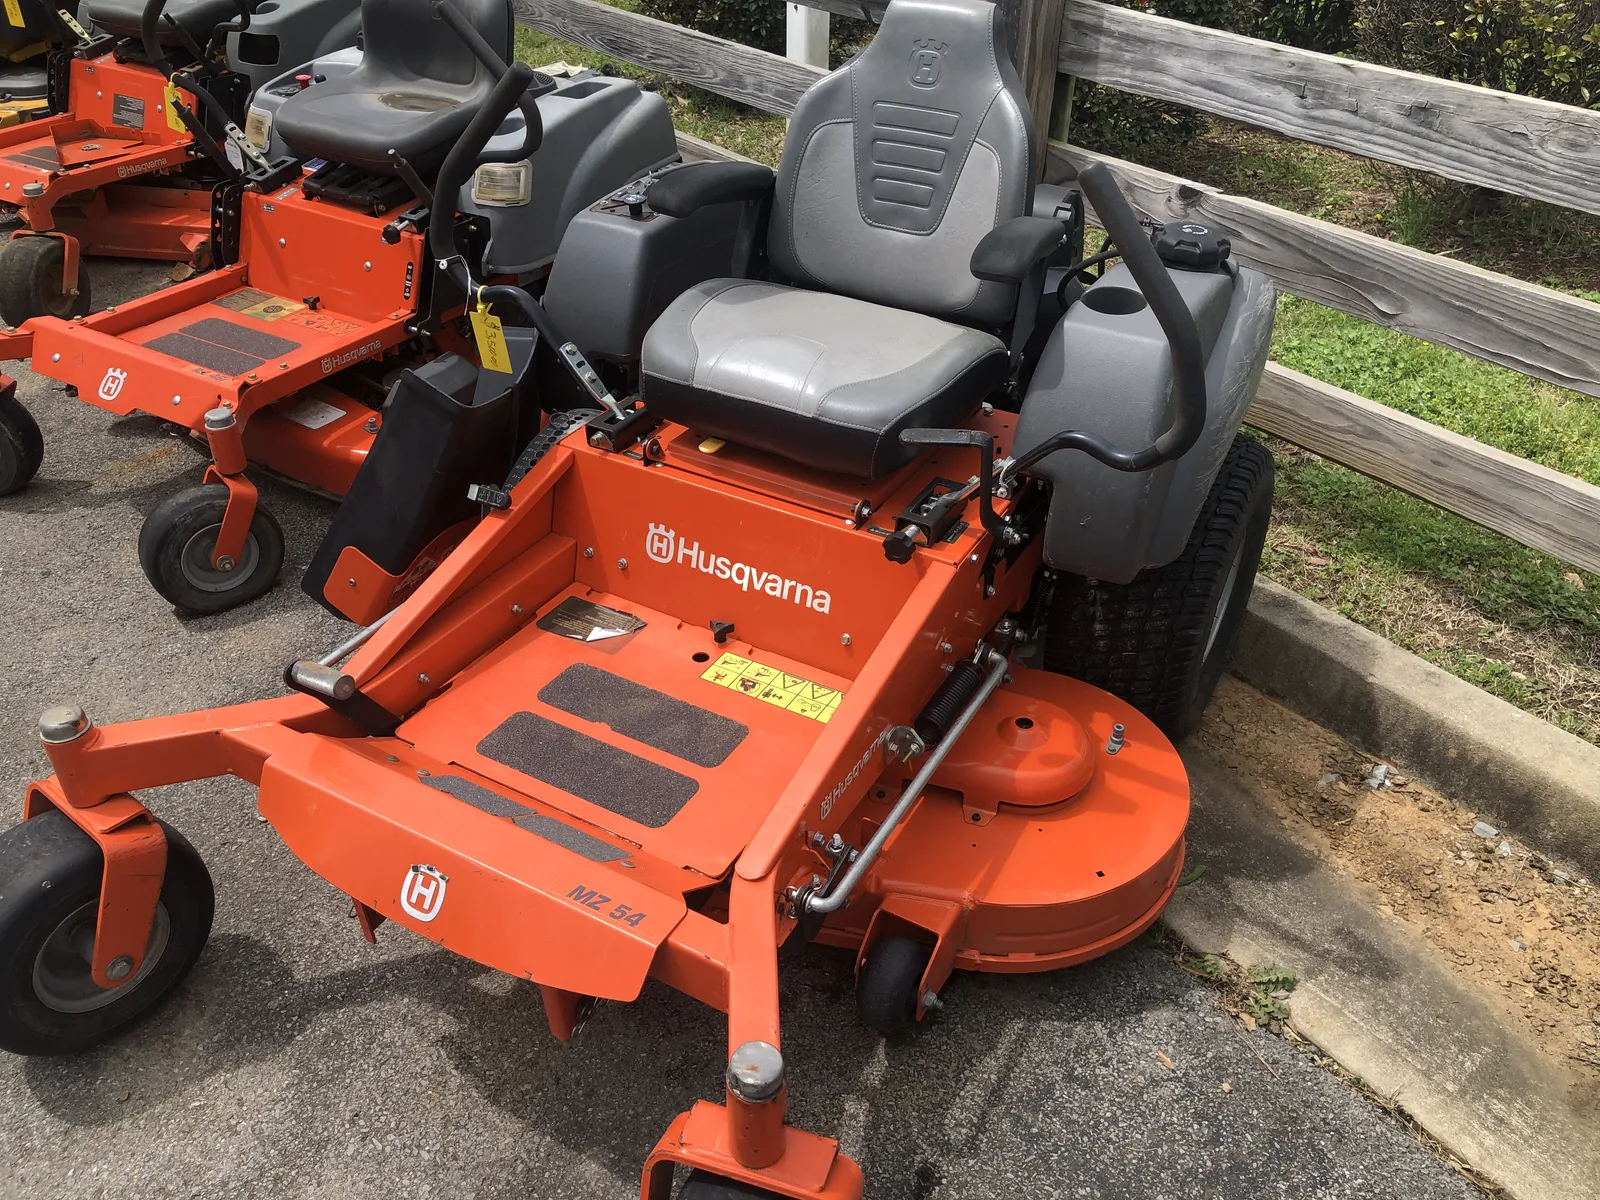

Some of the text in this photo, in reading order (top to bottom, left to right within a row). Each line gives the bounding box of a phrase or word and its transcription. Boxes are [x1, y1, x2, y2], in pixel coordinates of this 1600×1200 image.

[126, 157, 167, 175] Husqvarna
[332, 339, 382, 368] Husqvarna
[676, 536, 832, 615] Husqvarna
[832, 730, 887, 805] Husqvarna
[566, 884, 647, 927] MZ 54
